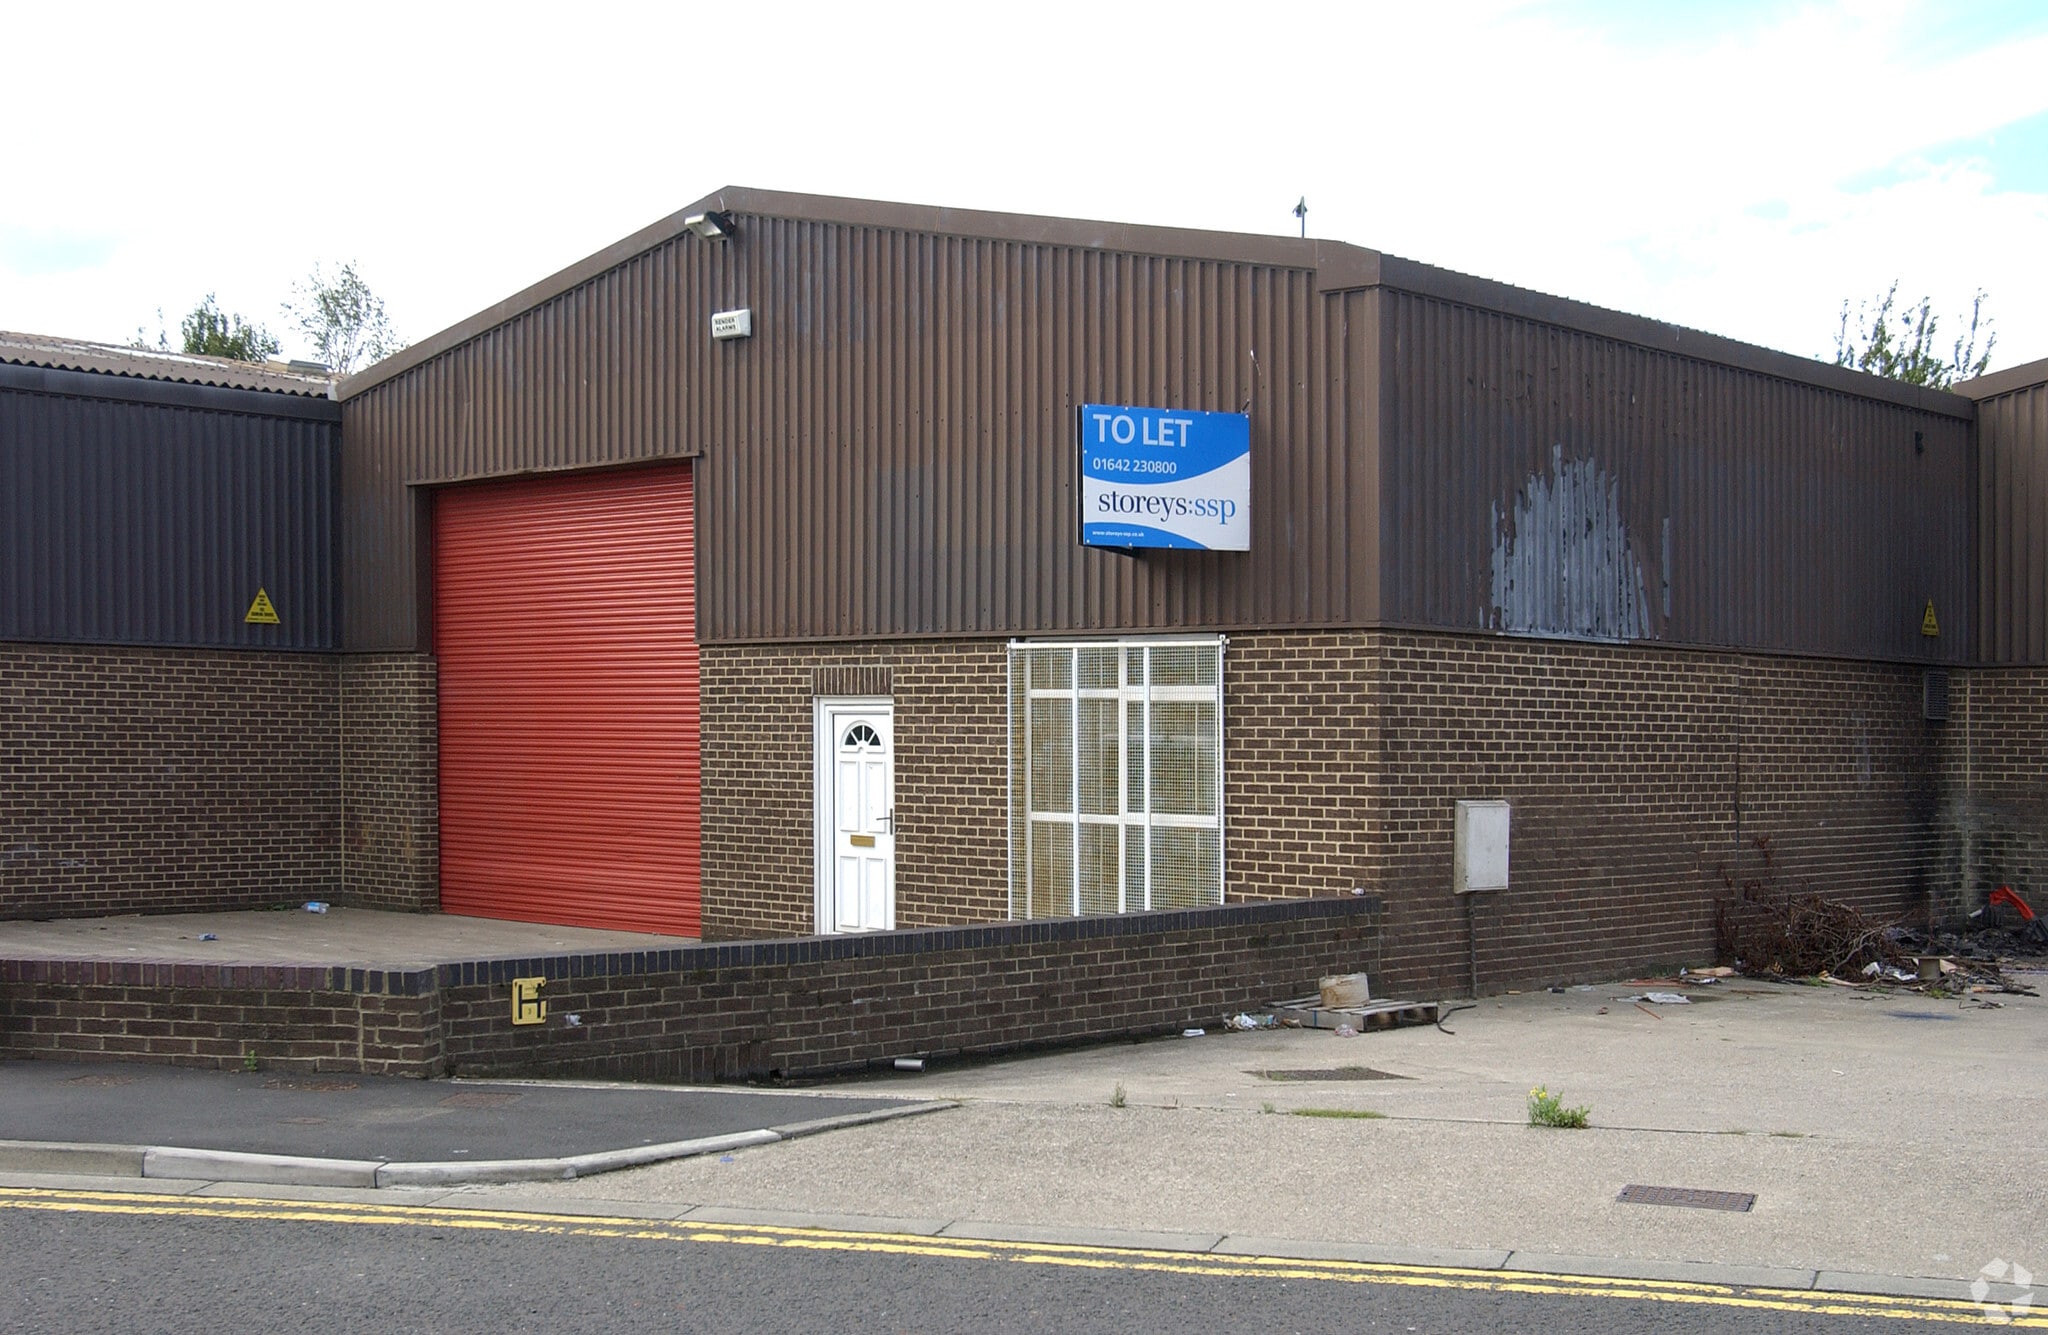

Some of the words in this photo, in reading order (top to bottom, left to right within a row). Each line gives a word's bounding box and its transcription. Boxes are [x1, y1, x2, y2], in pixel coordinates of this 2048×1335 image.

[1092, 413, 1136, 445] TO
[1142, 416, 1193, 448] LET
[1092, 457, 1131, 472] 01642
[1132, 459, 1178, 475] 230800
[1098, 490, 1237, 525] storeys:ssp
[518, 983, 542, 1020] H
